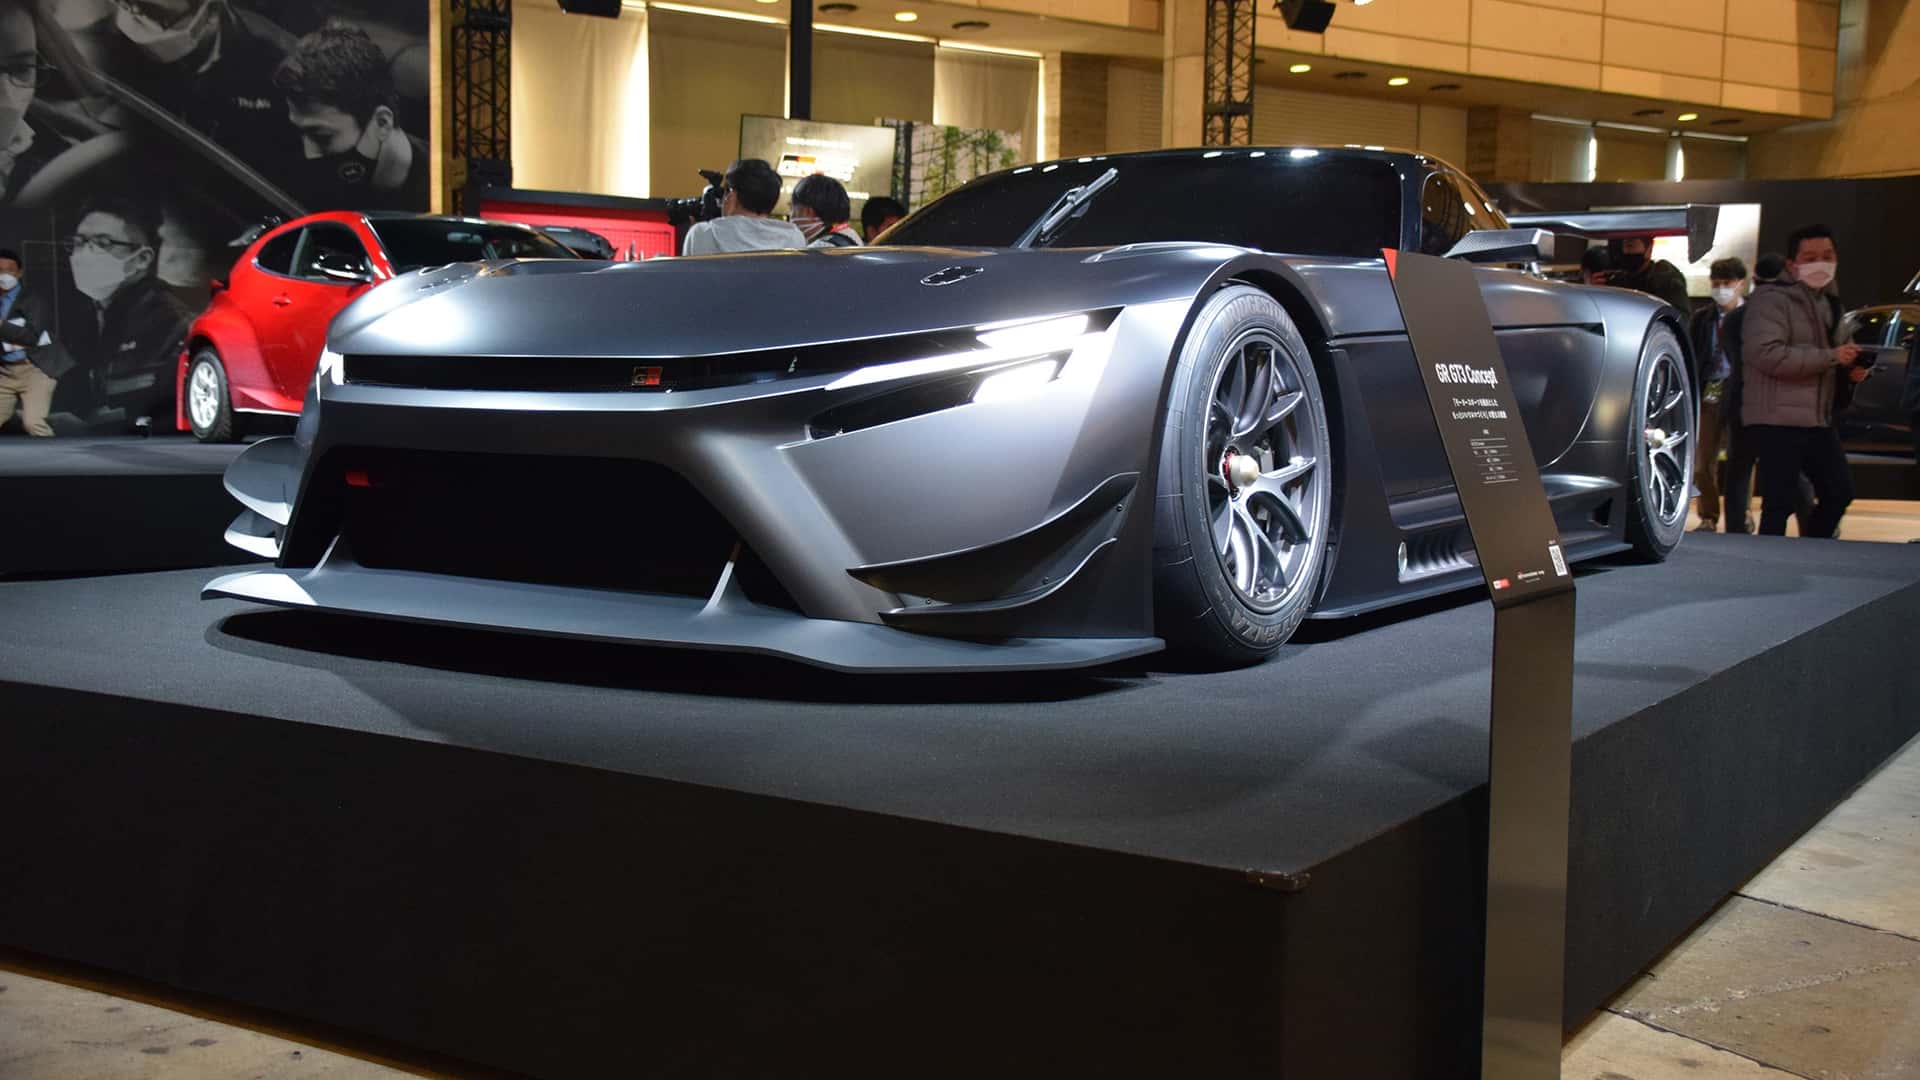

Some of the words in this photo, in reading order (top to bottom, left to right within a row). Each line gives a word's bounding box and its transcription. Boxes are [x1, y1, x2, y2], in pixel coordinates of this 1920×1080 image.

[1435, 363, 1452, 384] GR
[1448, 364, 1468, 384] GT3
[1465, 364, 1499, 389] Concept
